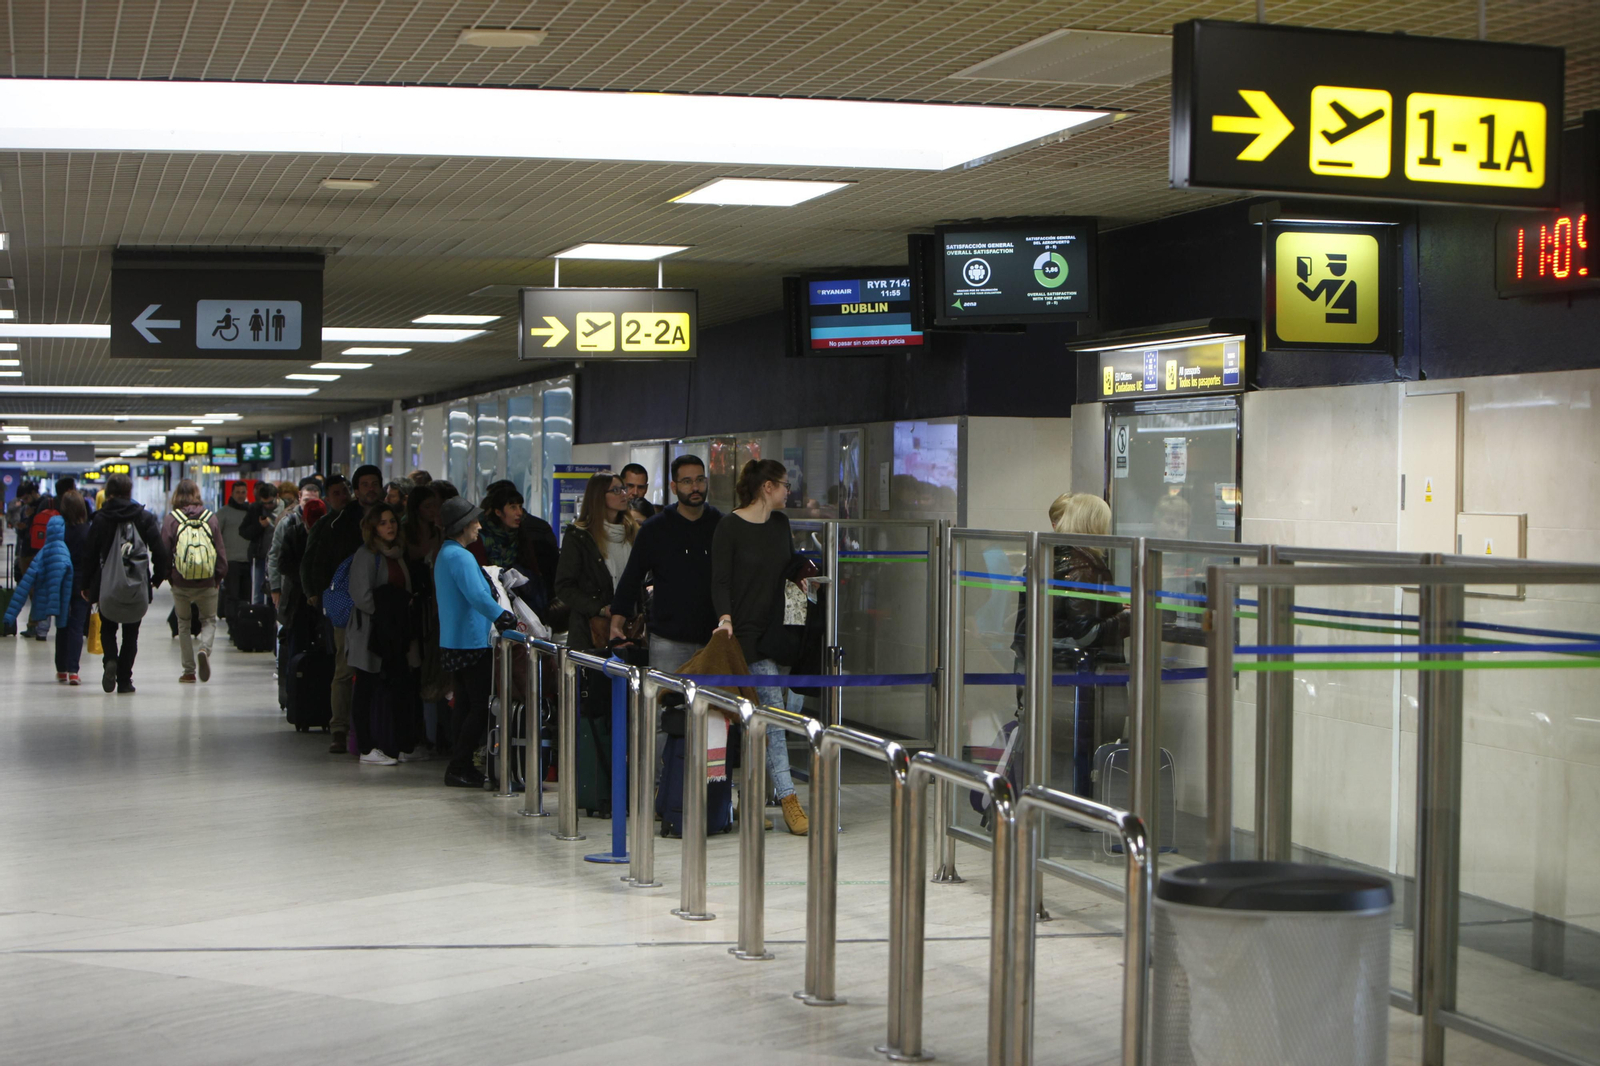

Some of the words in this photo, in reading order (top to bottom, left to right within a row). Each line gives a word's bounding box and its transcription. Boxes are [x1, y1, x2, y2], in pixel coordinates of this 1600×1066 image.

[1417, 108, 1534, 173] 1-1A
[841, 303, 888, 314] DUBLIN
[625, 319, 686, 345] 2-2A
